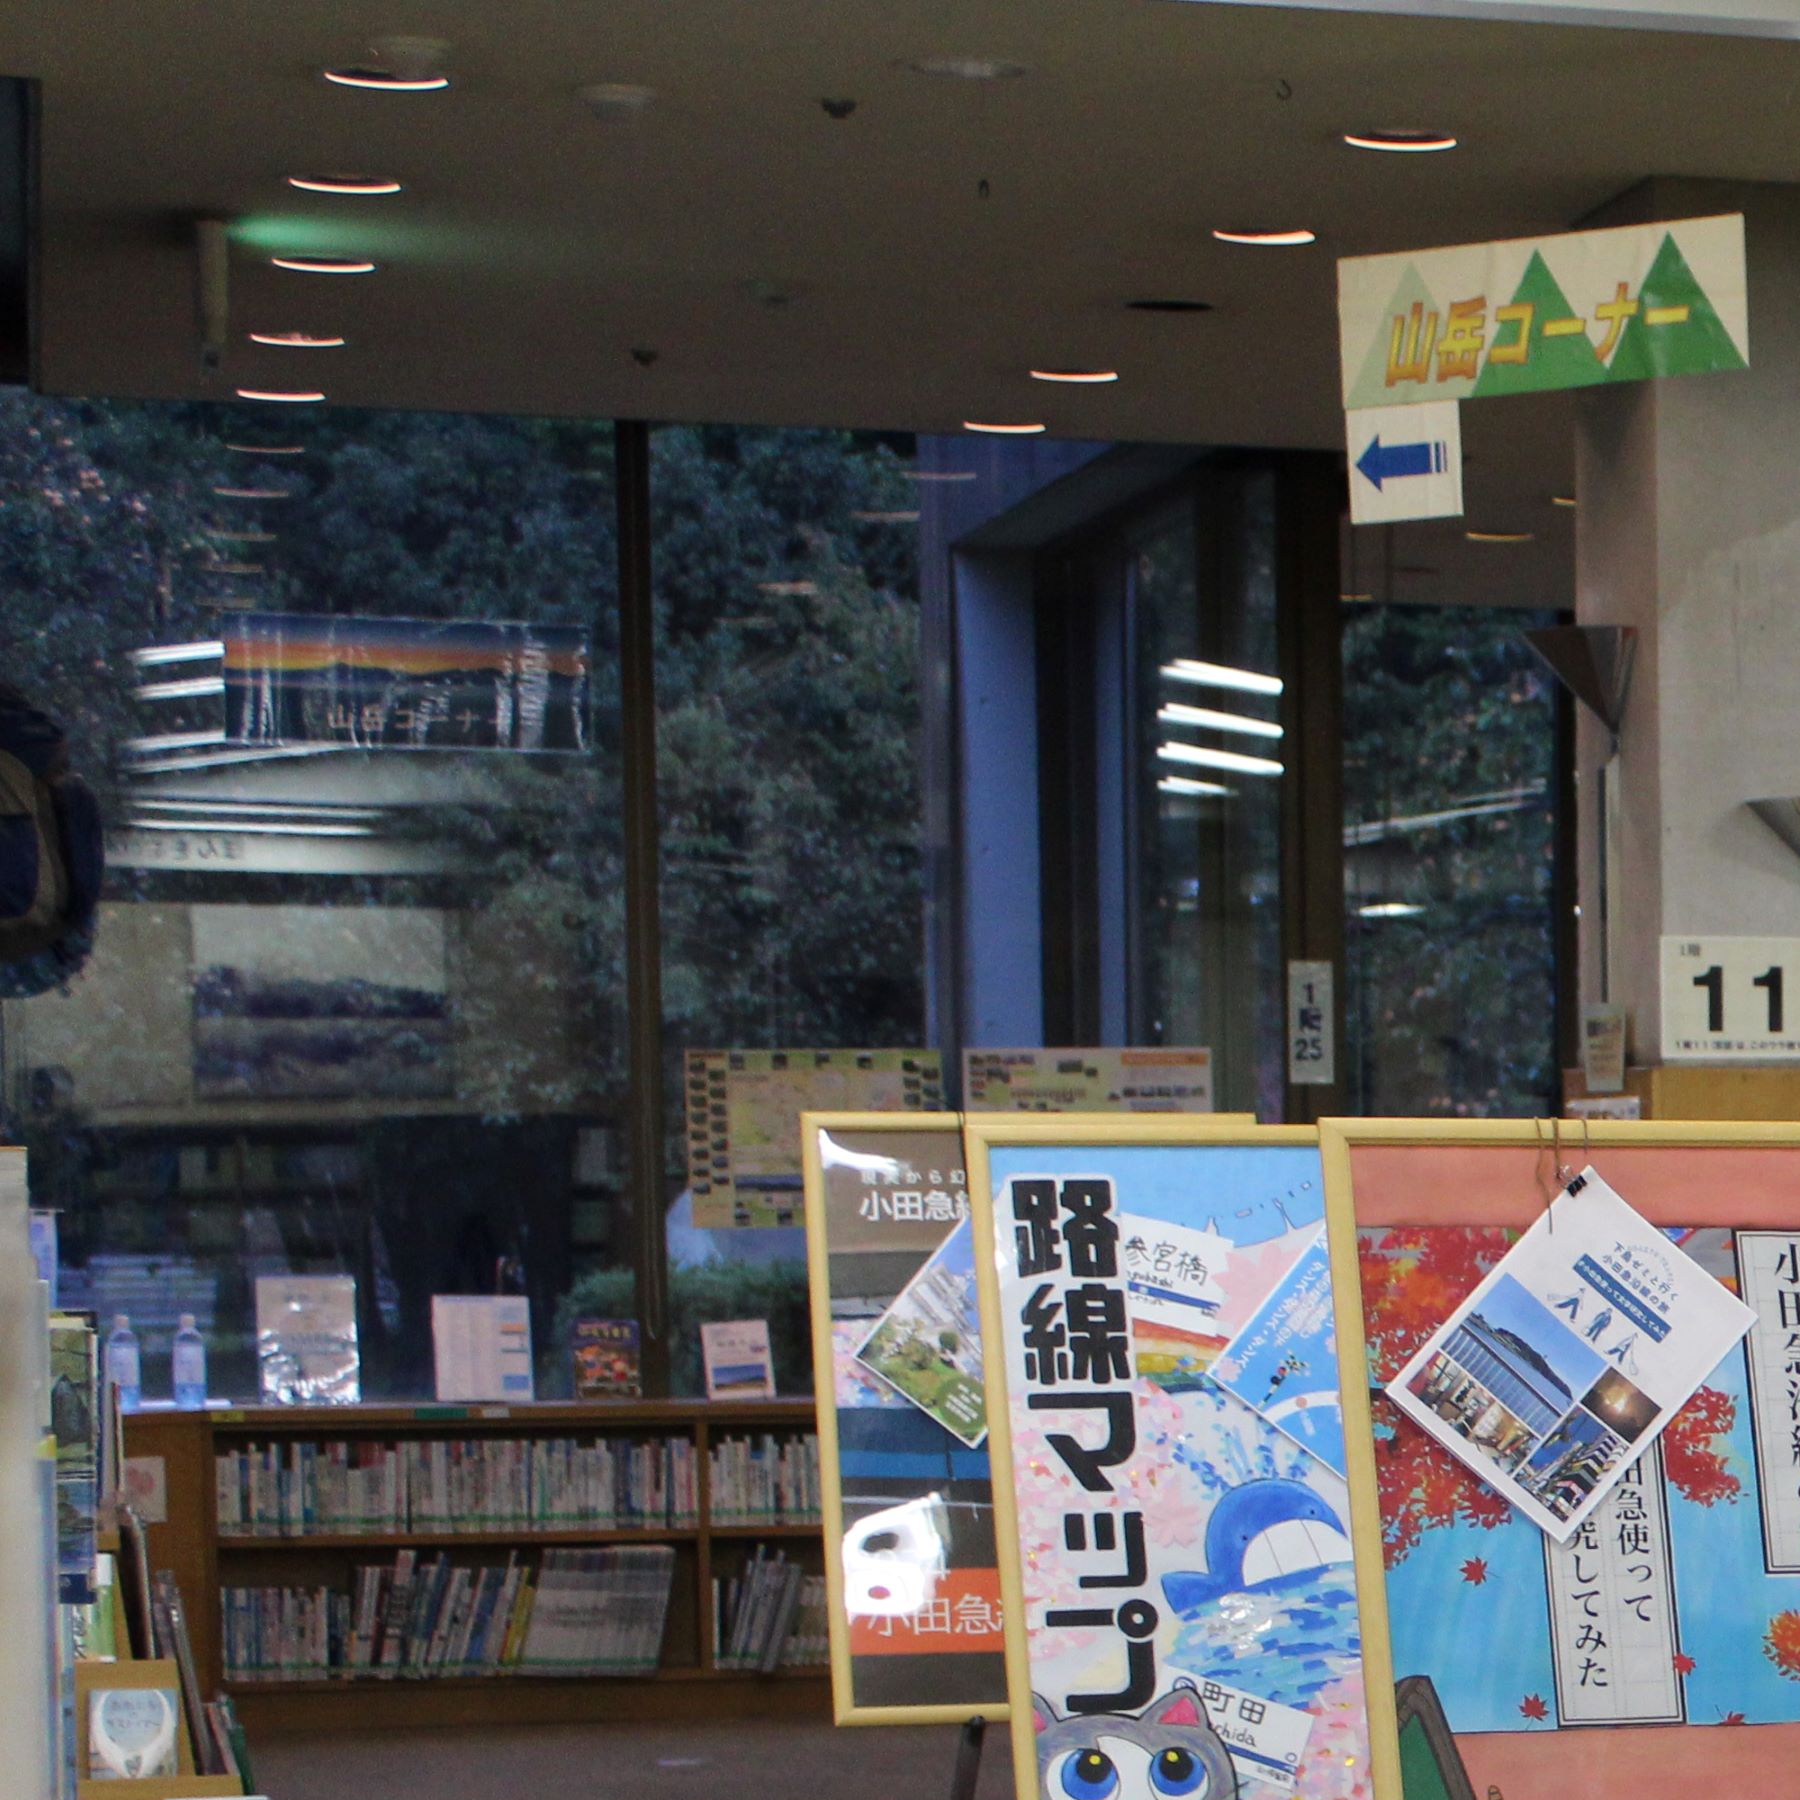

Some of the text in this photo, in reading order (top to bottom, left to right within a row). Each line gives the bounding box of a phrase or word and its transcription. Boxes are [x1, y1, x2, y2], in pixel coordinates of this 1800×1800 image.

[1385, 281, 1690, 388] 山岳コーナー
[1693, 965, 1783, 1032] 11
[1124, 1235, 1209, 1287] 参宮橋
[1010, 1177, 1160, 1716] 路線マップ
[1202, 1681, 1267, 1725] 町田
